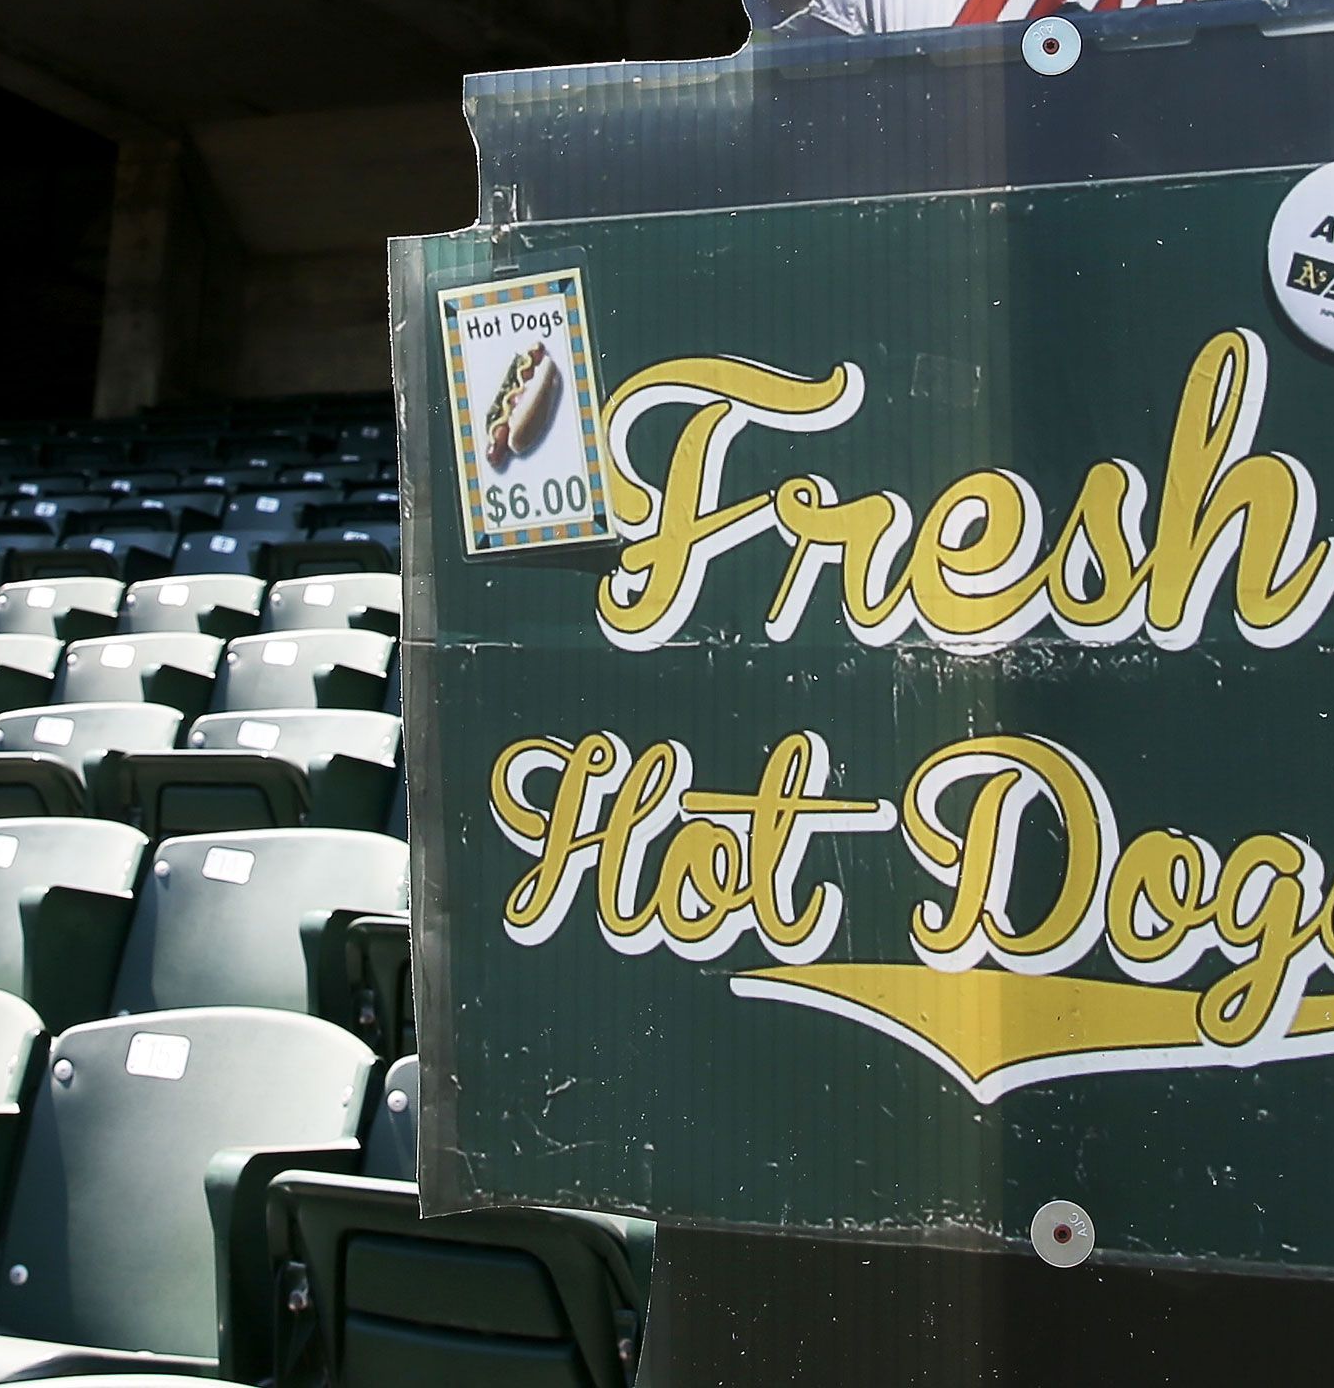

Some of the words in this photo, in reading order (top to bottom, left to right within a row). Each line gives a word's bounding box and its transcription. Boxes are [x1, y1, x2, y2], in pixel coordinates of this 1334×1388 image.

[466, 316, 501, 340] Hot
[511, 310, 563, 338] Dogs
[486, 475, 587, 528] $6.00
[490, 730, 898, 958] Hot
